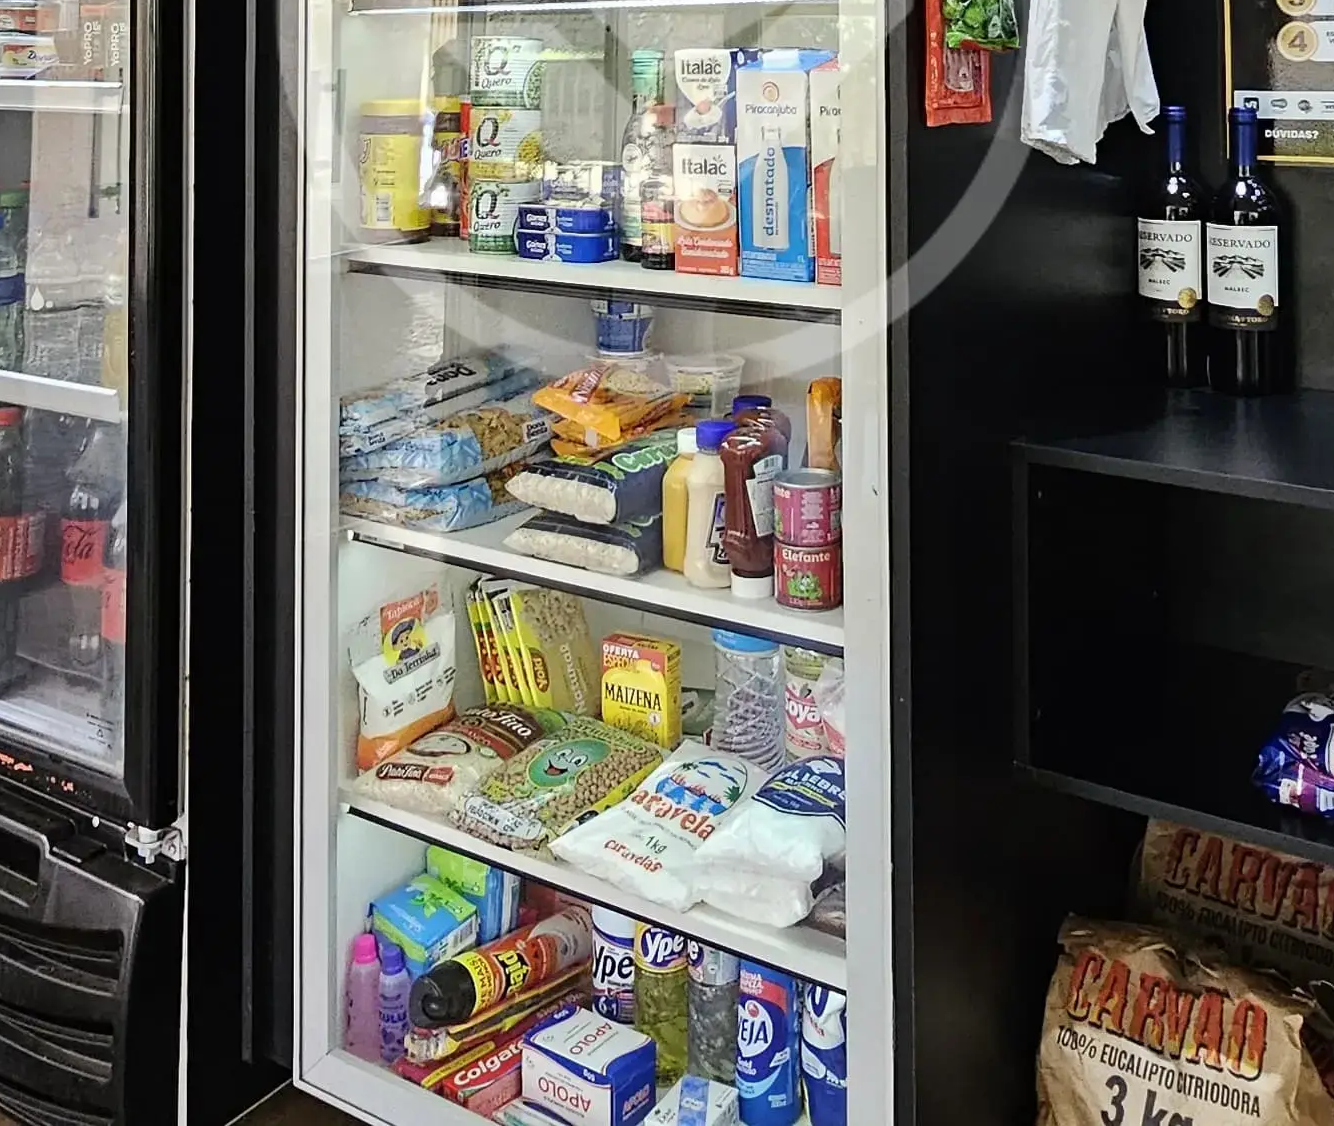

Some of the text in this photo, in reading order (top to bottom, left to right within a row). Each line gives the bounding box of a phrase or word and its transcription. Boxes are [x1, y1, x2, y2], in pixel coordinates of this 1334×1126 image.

[1287, 30, 1308, 51] 4
[681, 58, 722, 75] Italac
[474, 149, 502, 161] Quero
[681, 157, 727, 175] Italac
[764, 147, 776, 237] desnatado
[782, 548, 831, 563] Elefante
[602, 643, 640, 659] OFERTA
[605, 682, 662, 711] MAIZENA
[1100, 1043, 1175, 1089] EUCALIPTO
[1177, 1072, 1261, 1118] CITRIODORA
[1101, 1075, 1127, 1125] 3
